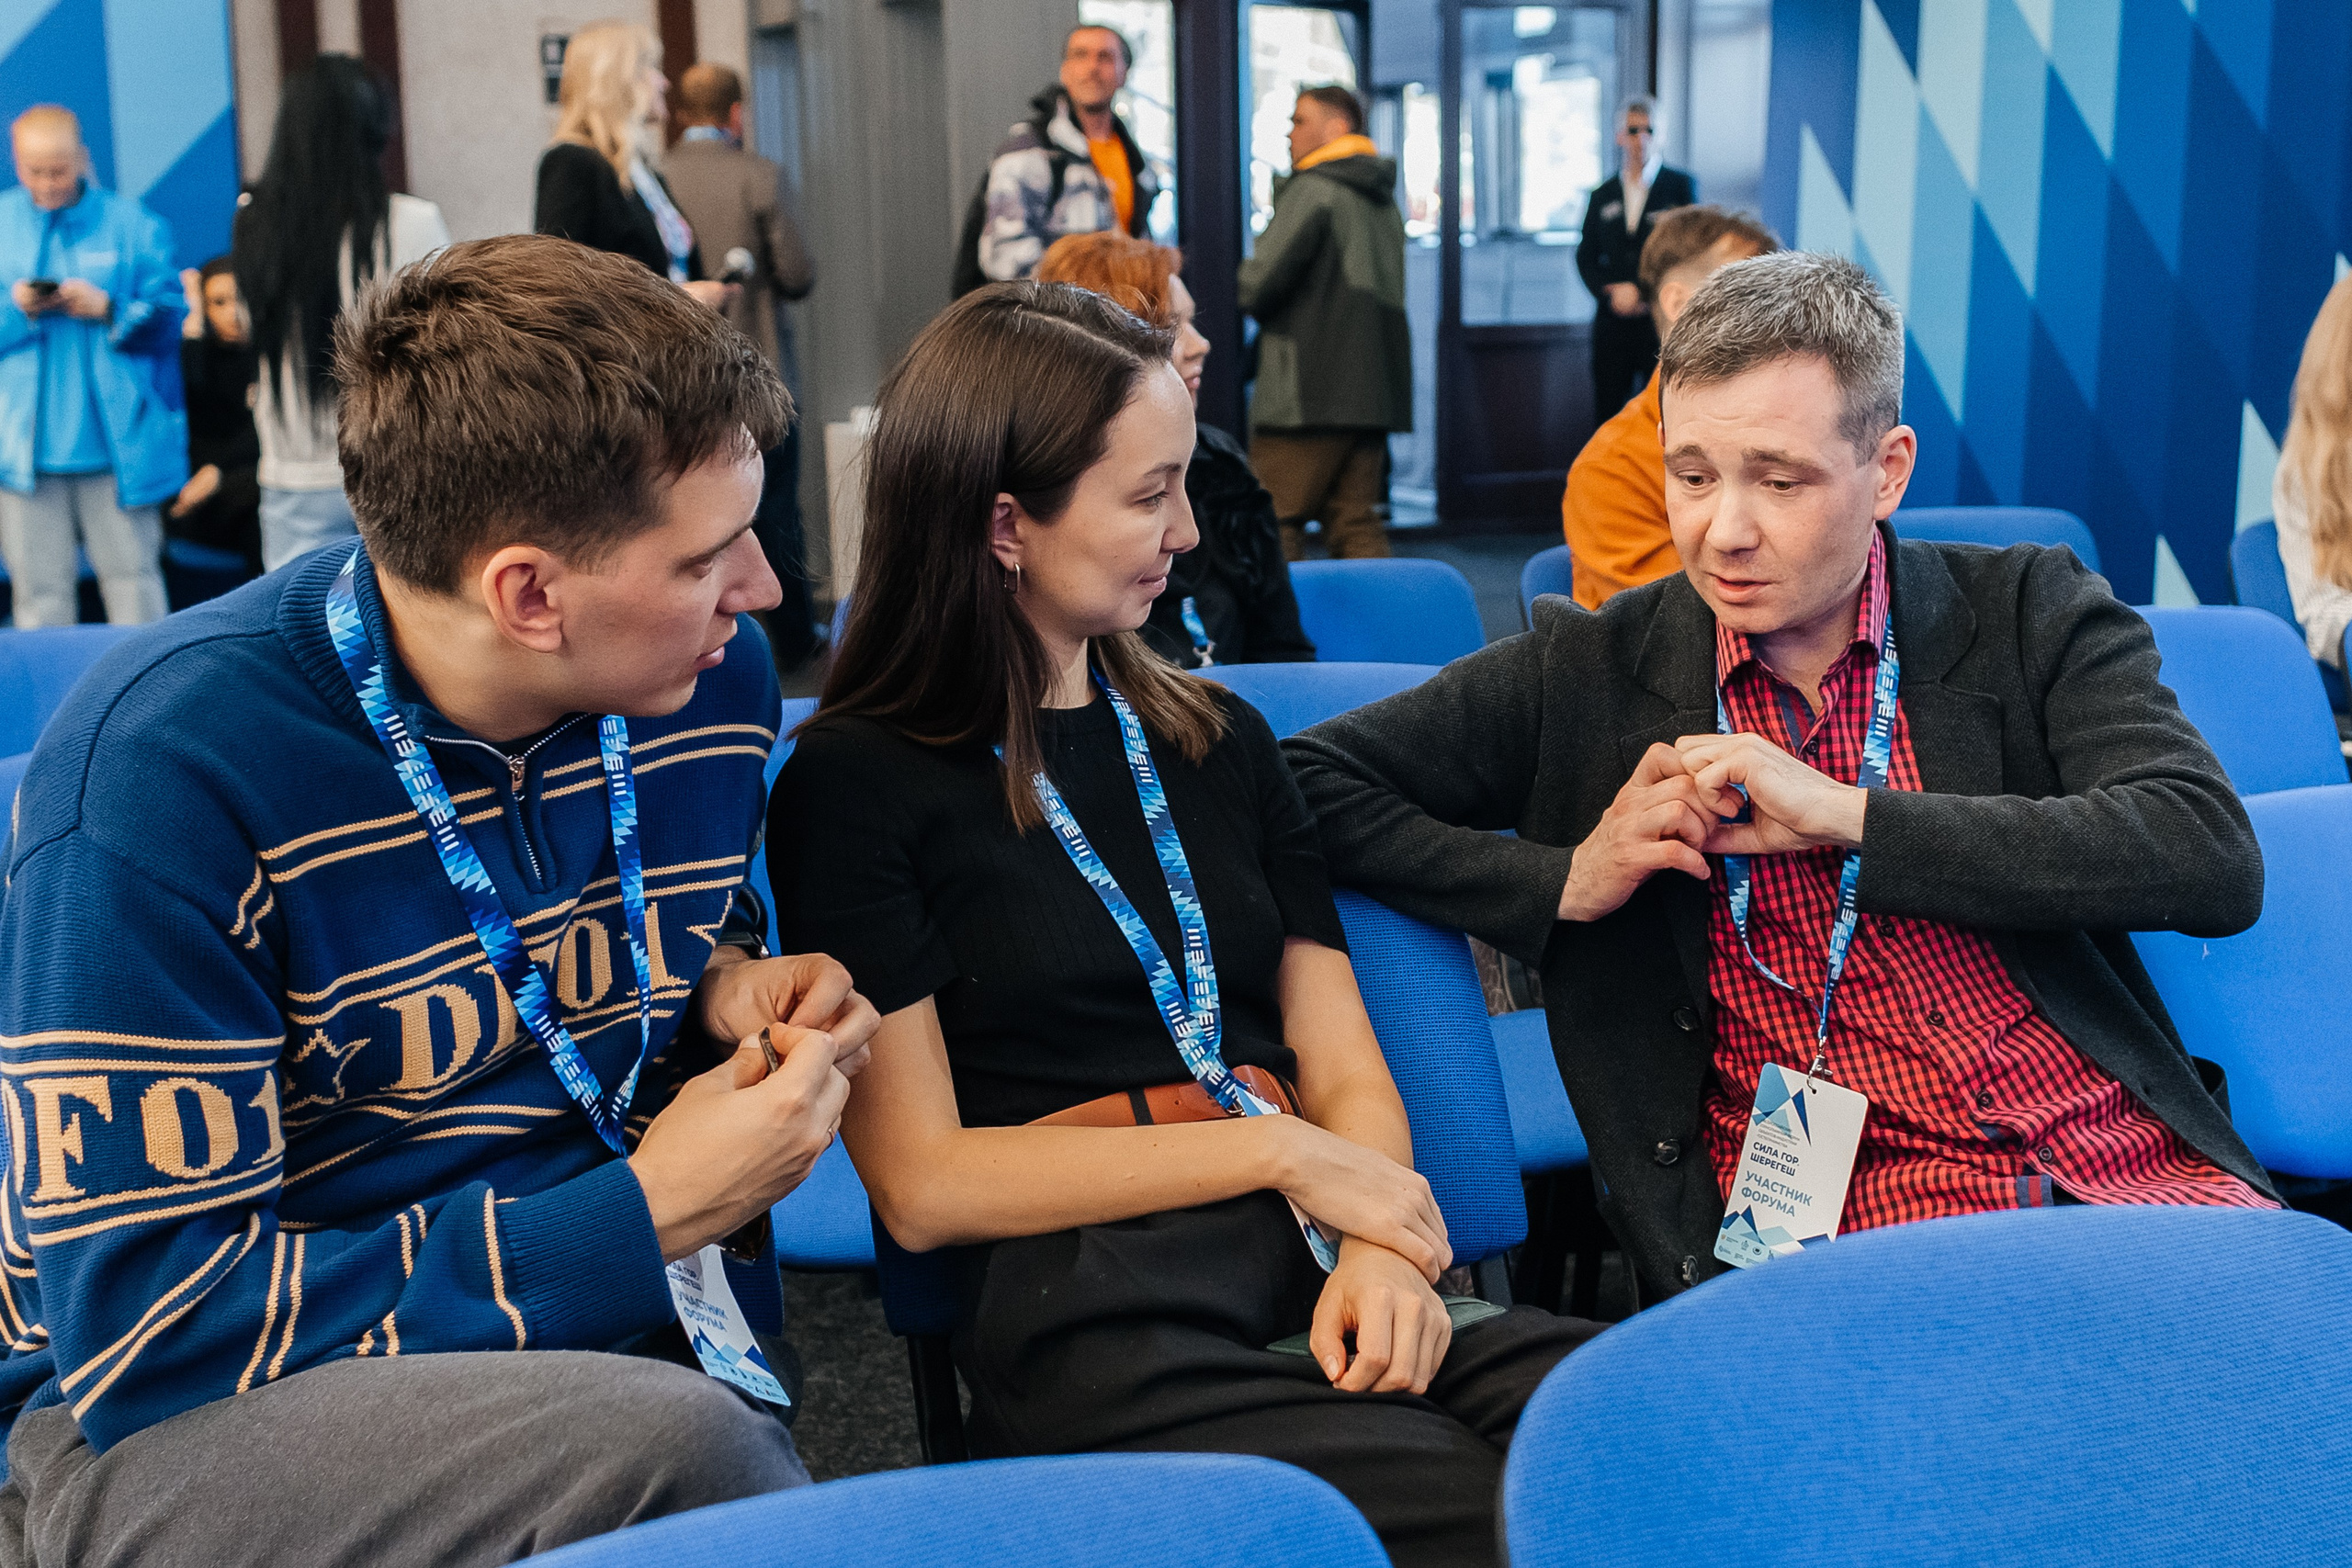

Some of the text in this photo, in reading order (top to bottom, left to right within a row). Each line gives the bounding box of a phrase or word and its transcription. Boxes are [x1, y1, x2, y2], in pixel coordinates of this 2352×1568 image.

[1753, 1141, 1779, 1158] СИЛА
[1749, 1152, 1796, 1177] ШЕРЕГЕШ
[1741, 1186, 1795, 1217] ФОРУМА
[1745, 1170, 1813, 1206] УЧАСТНИК
